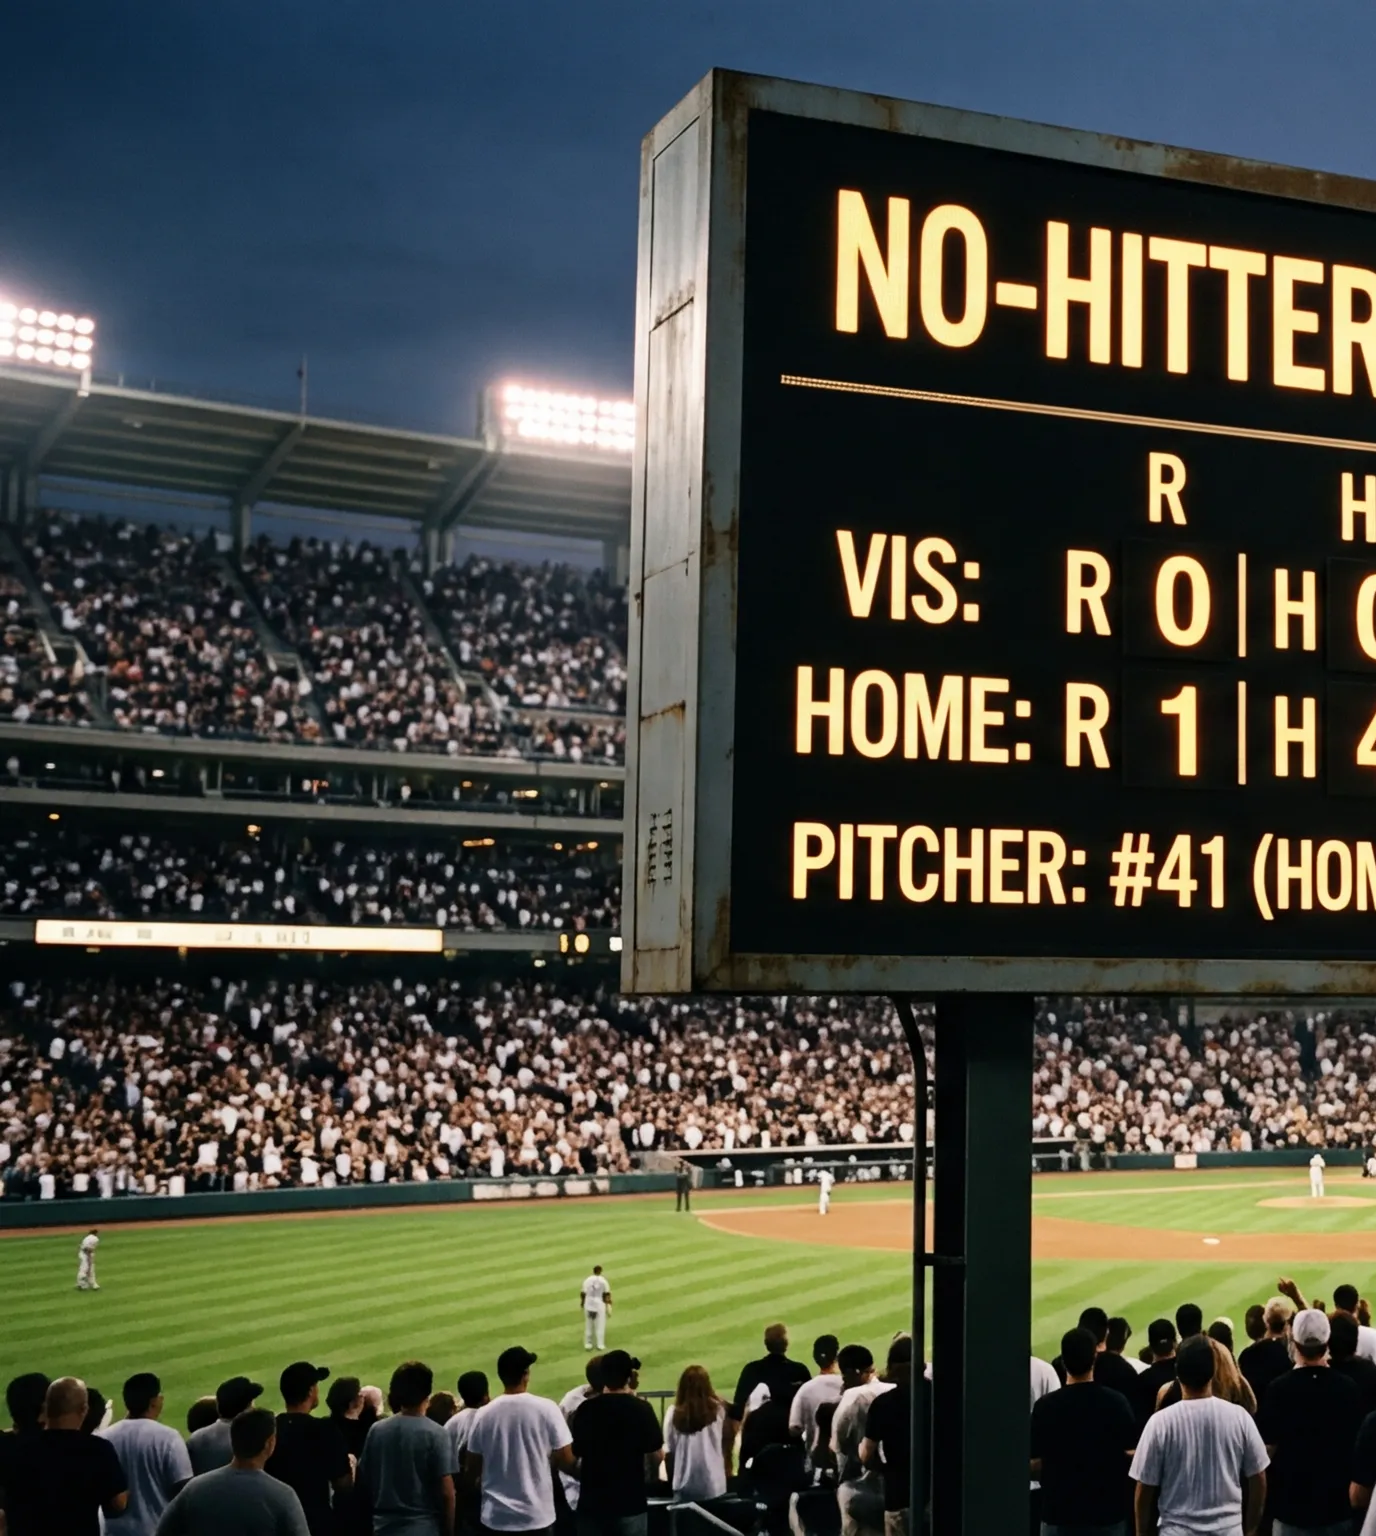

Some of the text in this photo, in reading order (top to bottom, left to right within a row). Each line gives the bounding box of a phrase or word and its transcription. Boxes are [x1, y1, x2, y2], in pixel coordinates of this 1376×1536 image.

[1147, 450, 1188, 527] R
[835, 528, 981, 626] VIS:
[1065, 548, 1113, 637] R
[1154, 554, 1212, 648] 0
[1273, 567, 1318, 652] H
[795, 664, 1033, 765] HOME:
[1064, 681, 1112, 770] R
[1159, 684, 1198, 778] 1
[1273, 694, 1317, 780] H
[791, 820, 1087, 908] PITCHER:
[1108, 831, 1226, 910] #41
